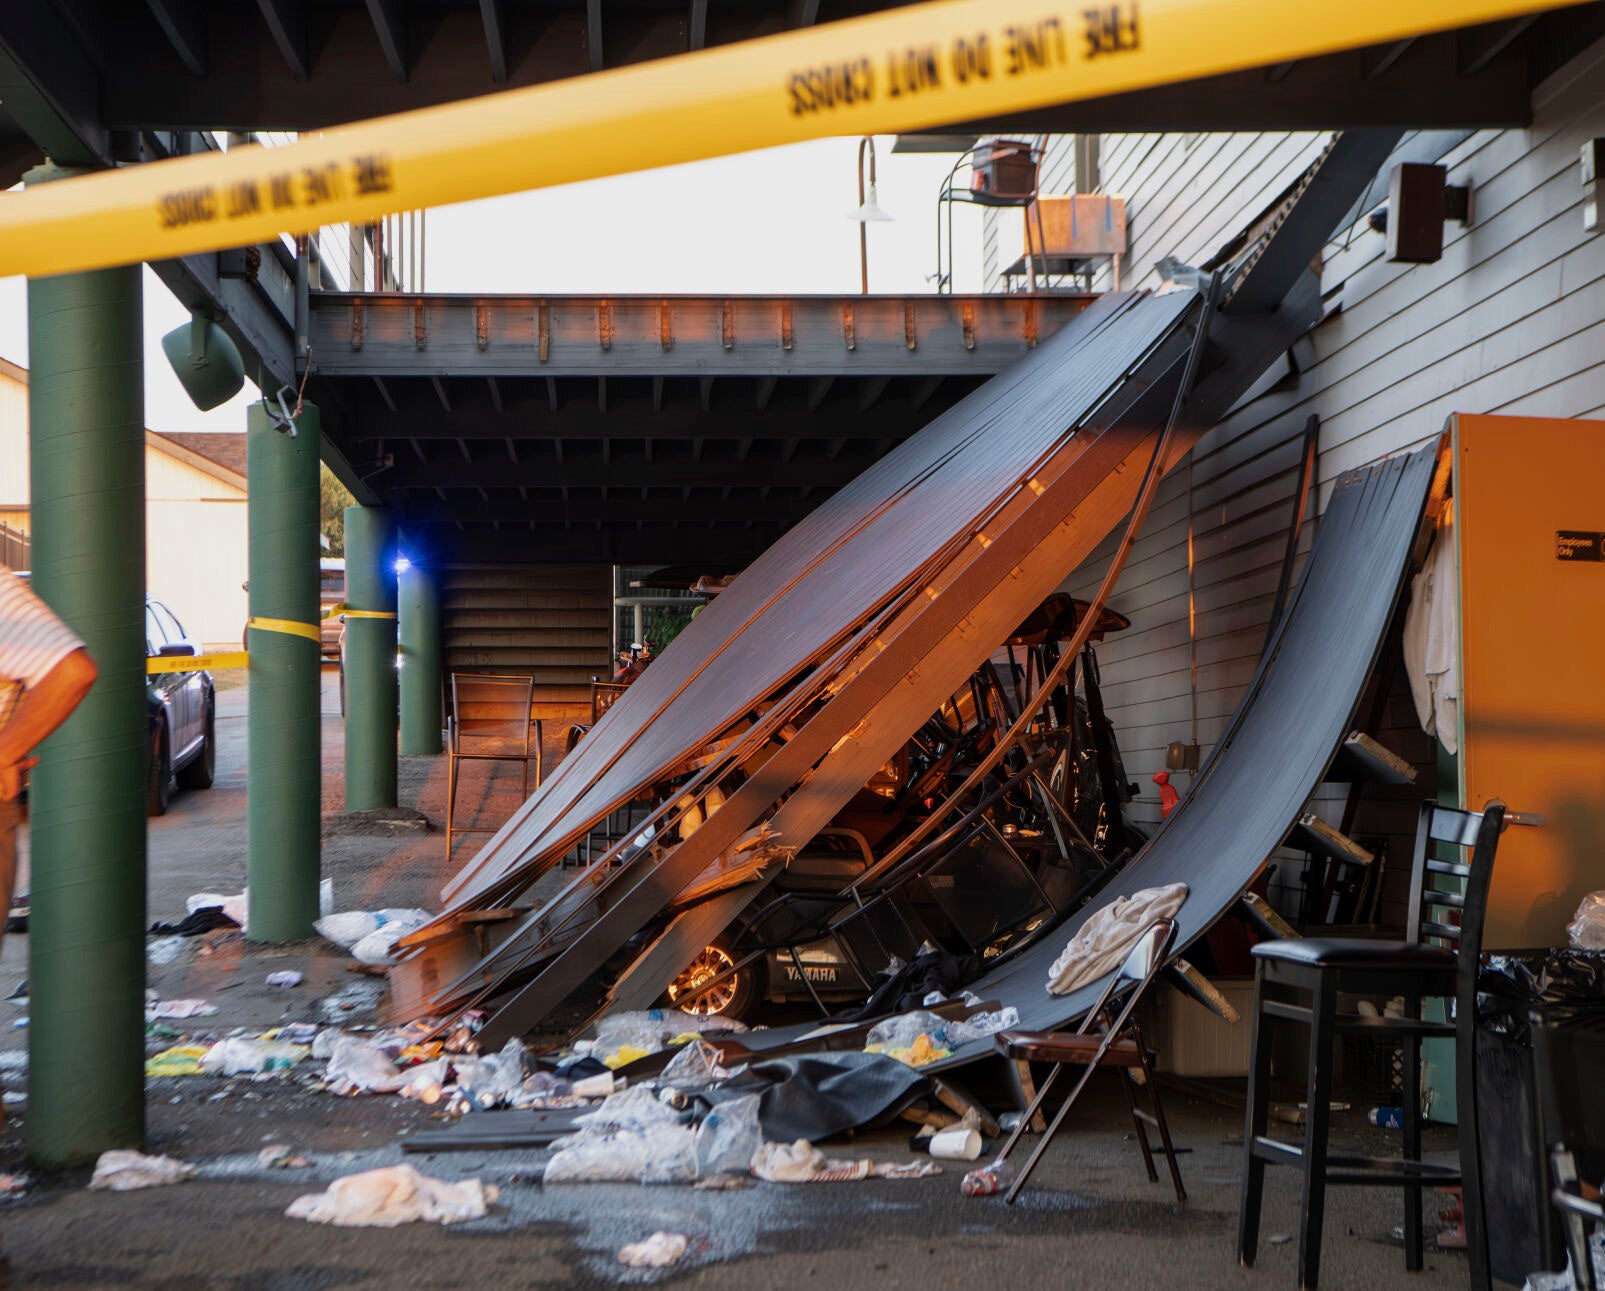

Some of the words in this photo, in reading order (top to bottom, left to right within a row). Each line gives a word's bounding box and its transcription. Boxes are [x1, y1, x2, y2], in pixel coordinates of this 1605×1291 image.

[1004, 17, 1067, 75] LINE
[1078, 3, 1140, 61] FIRE
[886, 47, 941, 98] NOT
[950, 33, 993, 83] DO
[788, 57, 873, 116] CROSS
[1558, 536, 1593, 547] Employees
[1558, 546, 1574, 557] Only
